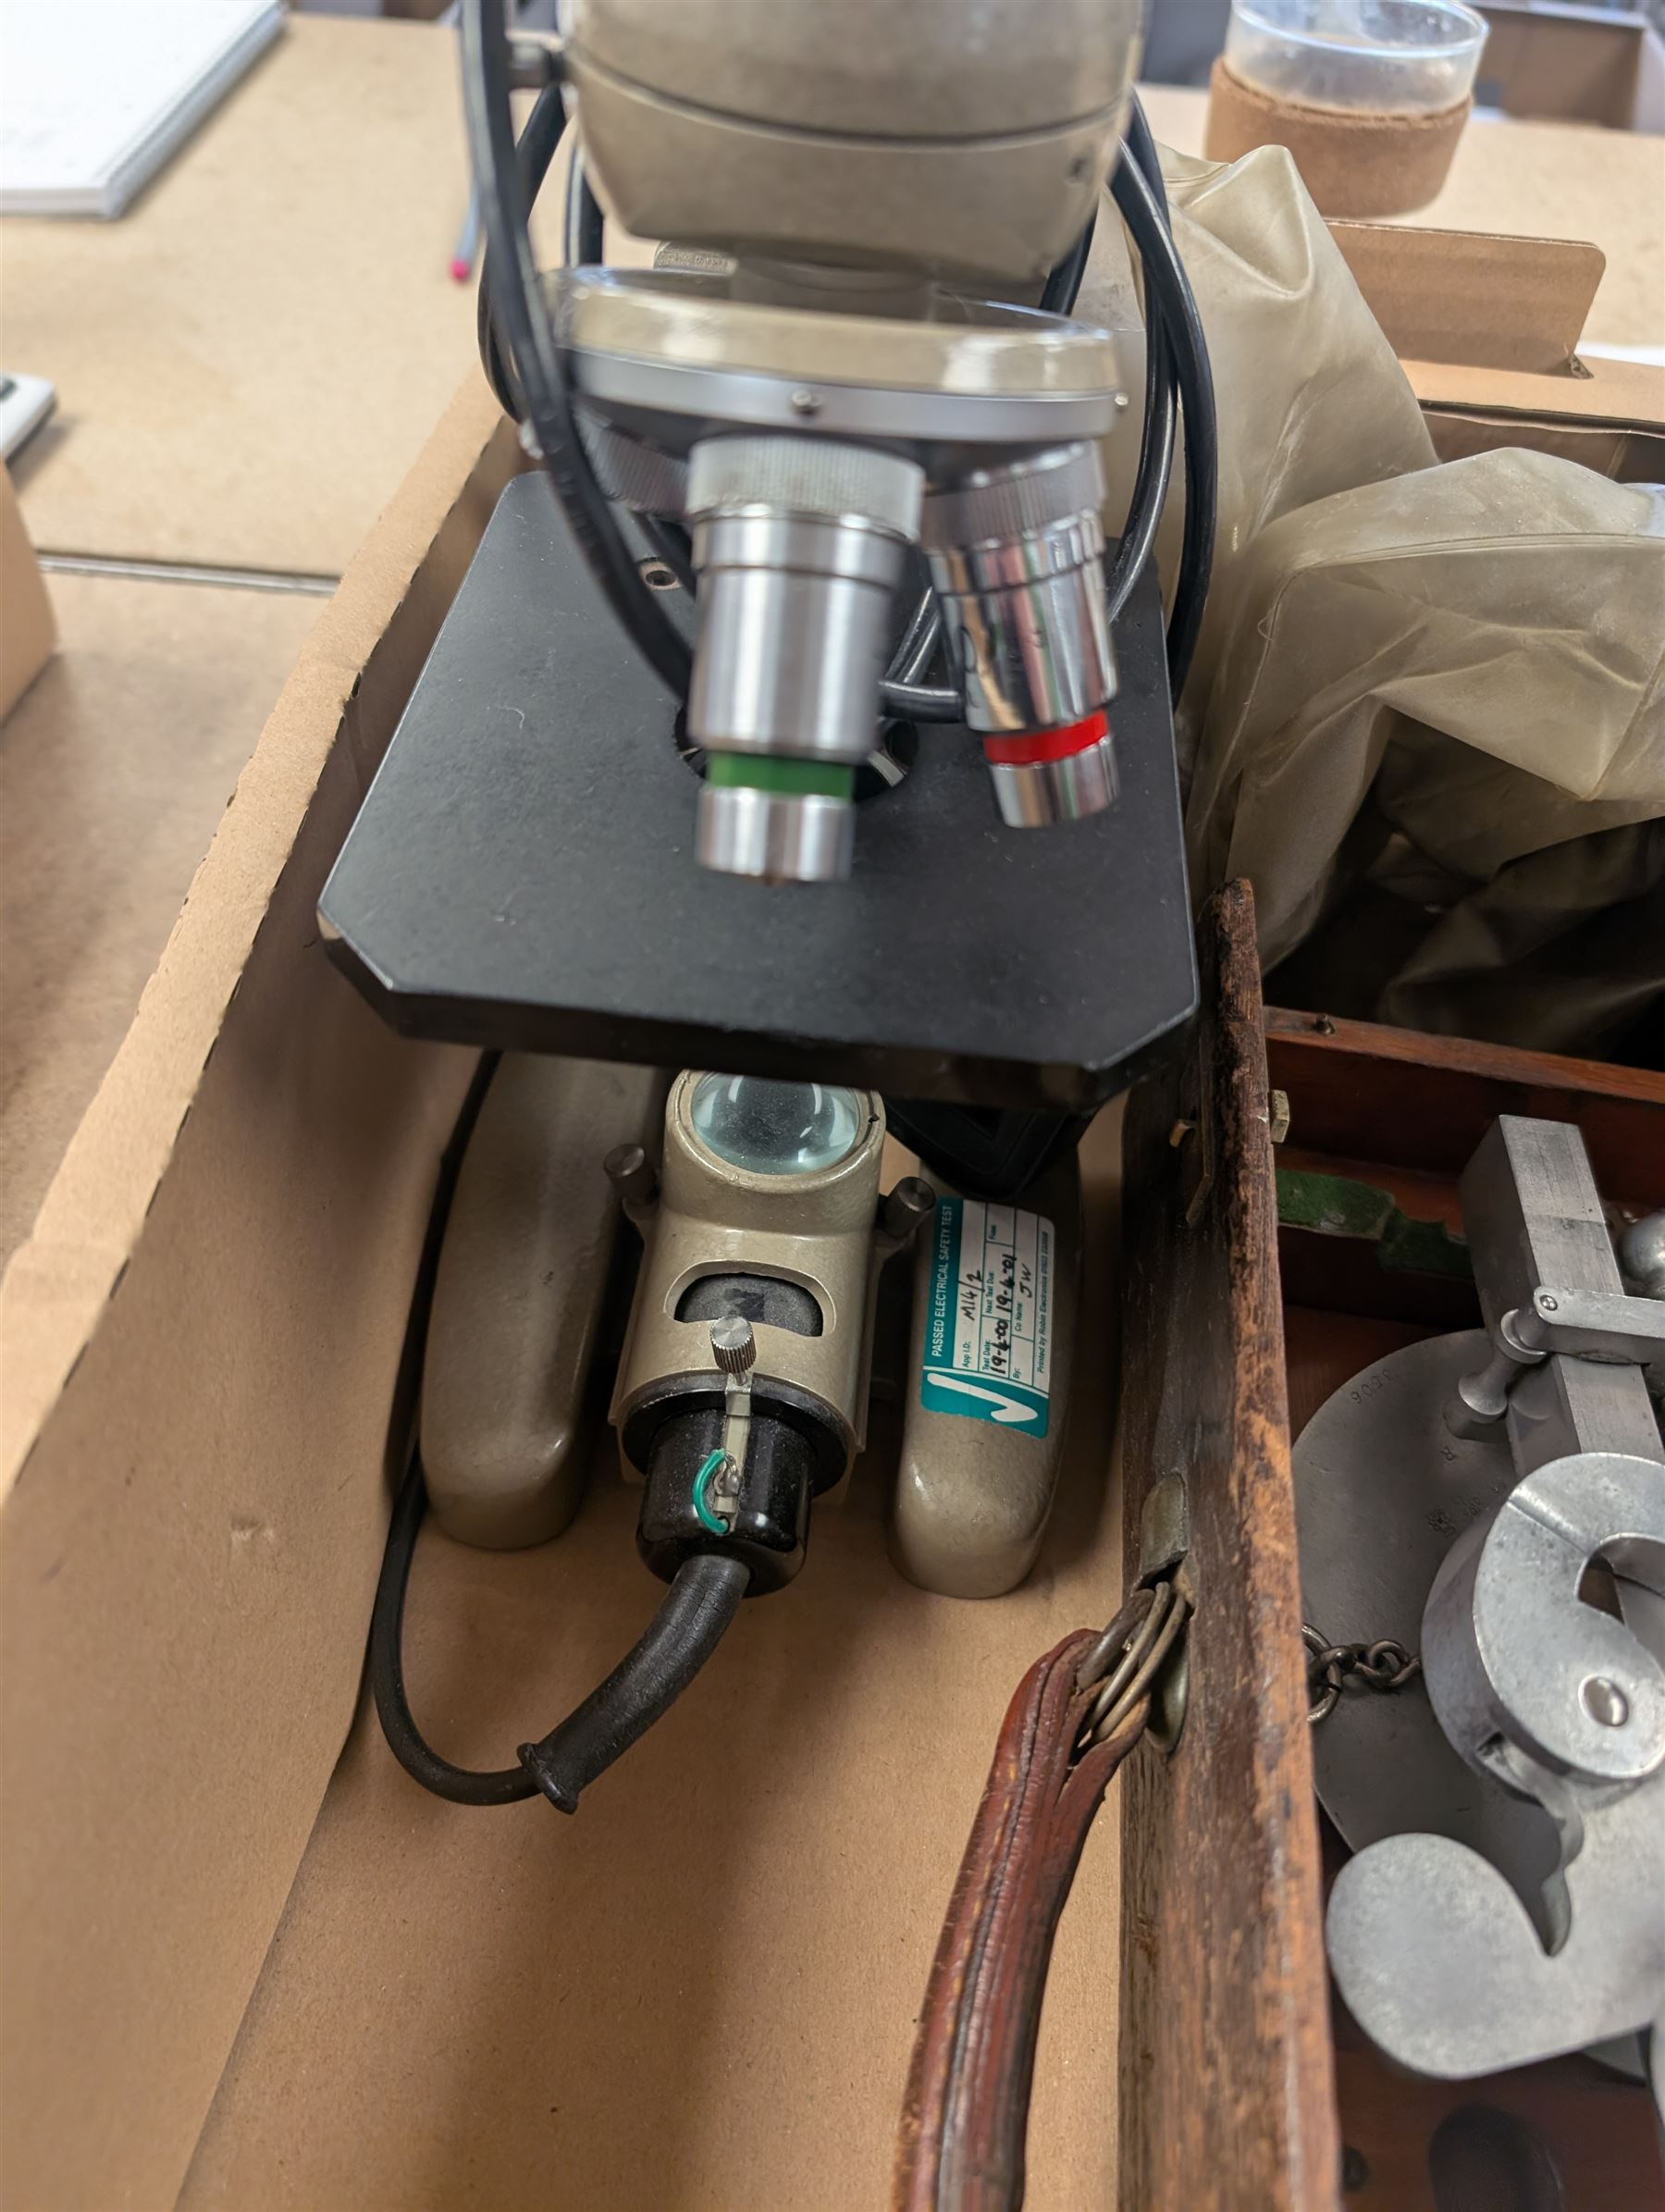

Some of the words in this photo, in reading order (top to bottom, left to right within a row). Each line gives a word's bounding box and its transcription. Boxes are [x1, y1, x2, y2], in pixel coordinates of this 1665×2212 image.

[941, 1205, 953, 1226] TEST
[938, 1228, 952, 1260] SAFETY
[934, 1263, 949, 1316] ELECTRICAL
[1014, 1322, 1021, 1332] Co
[1039, 1314, 1047, 1335] Robin
[931, 1319, 944, 1358] PASSED
[1038, 1336, 1047, 1346] by
[962, 1354, 972, 1367] App
[982, 1357, 991, 1370] Test
[1037, 1347, 1046, 1374] Printed
